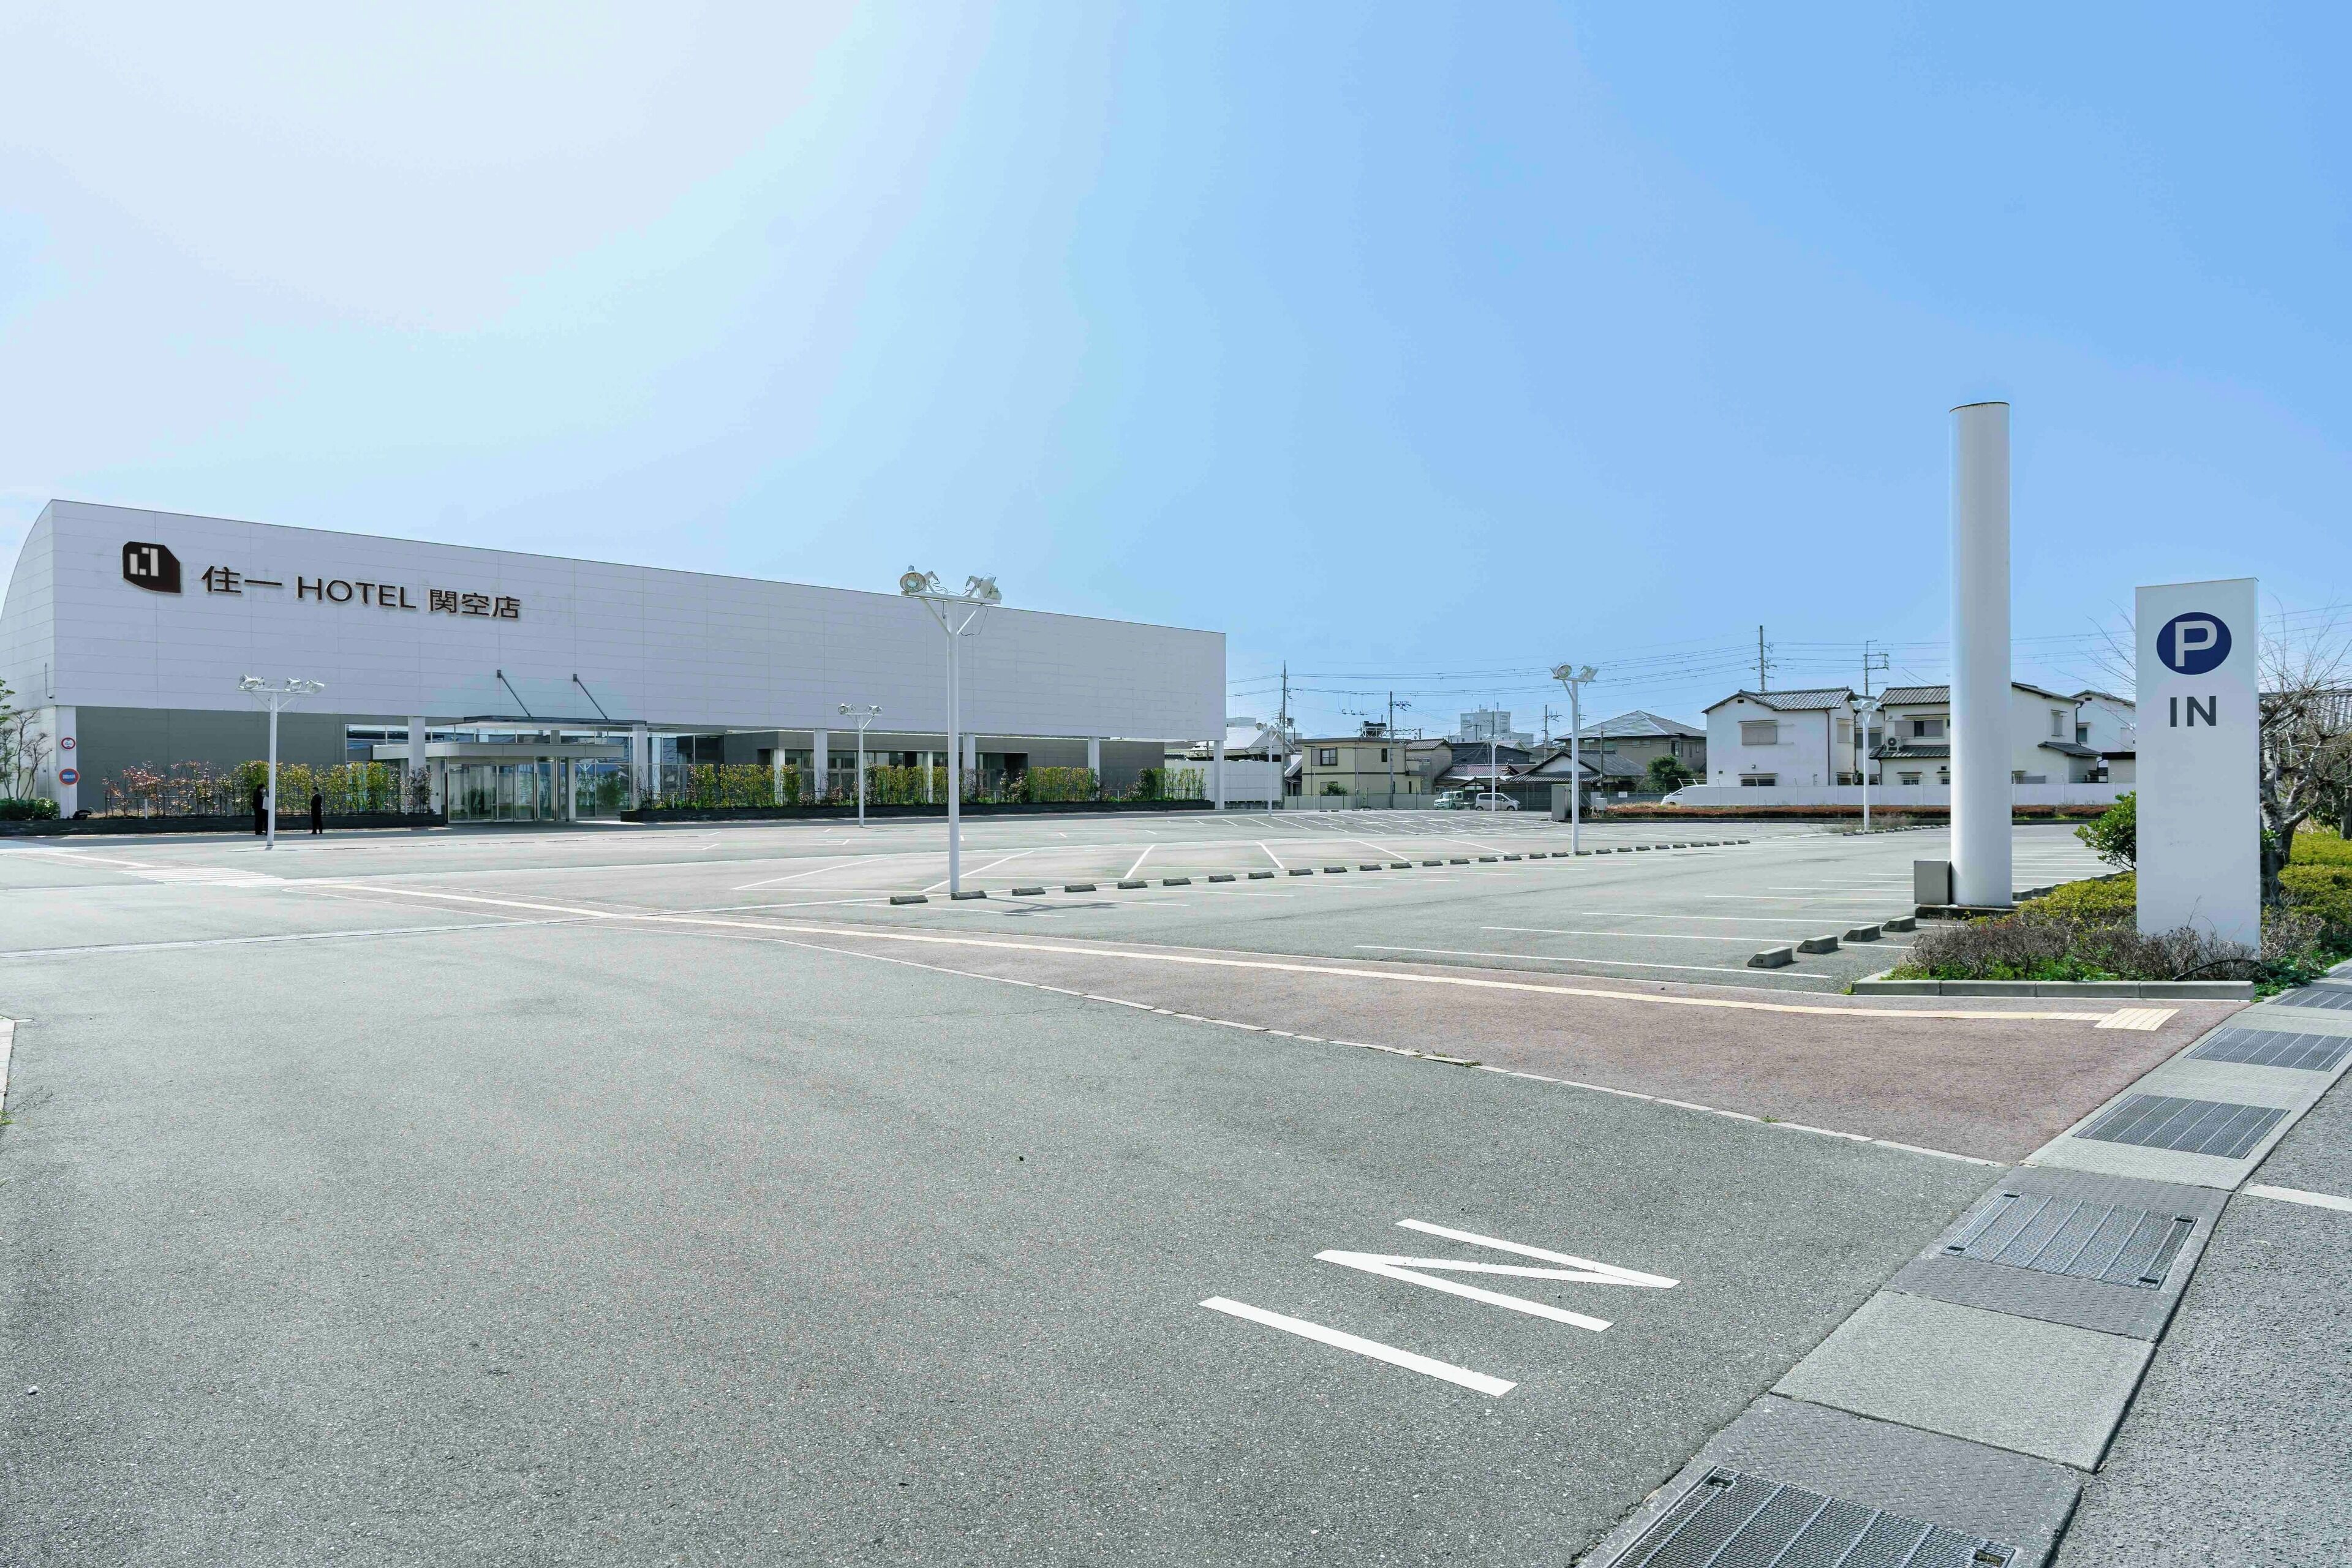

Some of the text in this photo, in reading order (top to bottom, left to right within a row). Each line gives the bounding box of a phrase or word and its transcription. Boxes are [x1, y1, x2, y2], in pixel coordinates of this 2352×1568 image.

[201, 565, 520, 619] 住一 HOTEL 関空店
[2175, 620, 2217, 667] P
[2170, 696, 2217, 727] IN
[1198, 1218, 1681, 1398] IN
